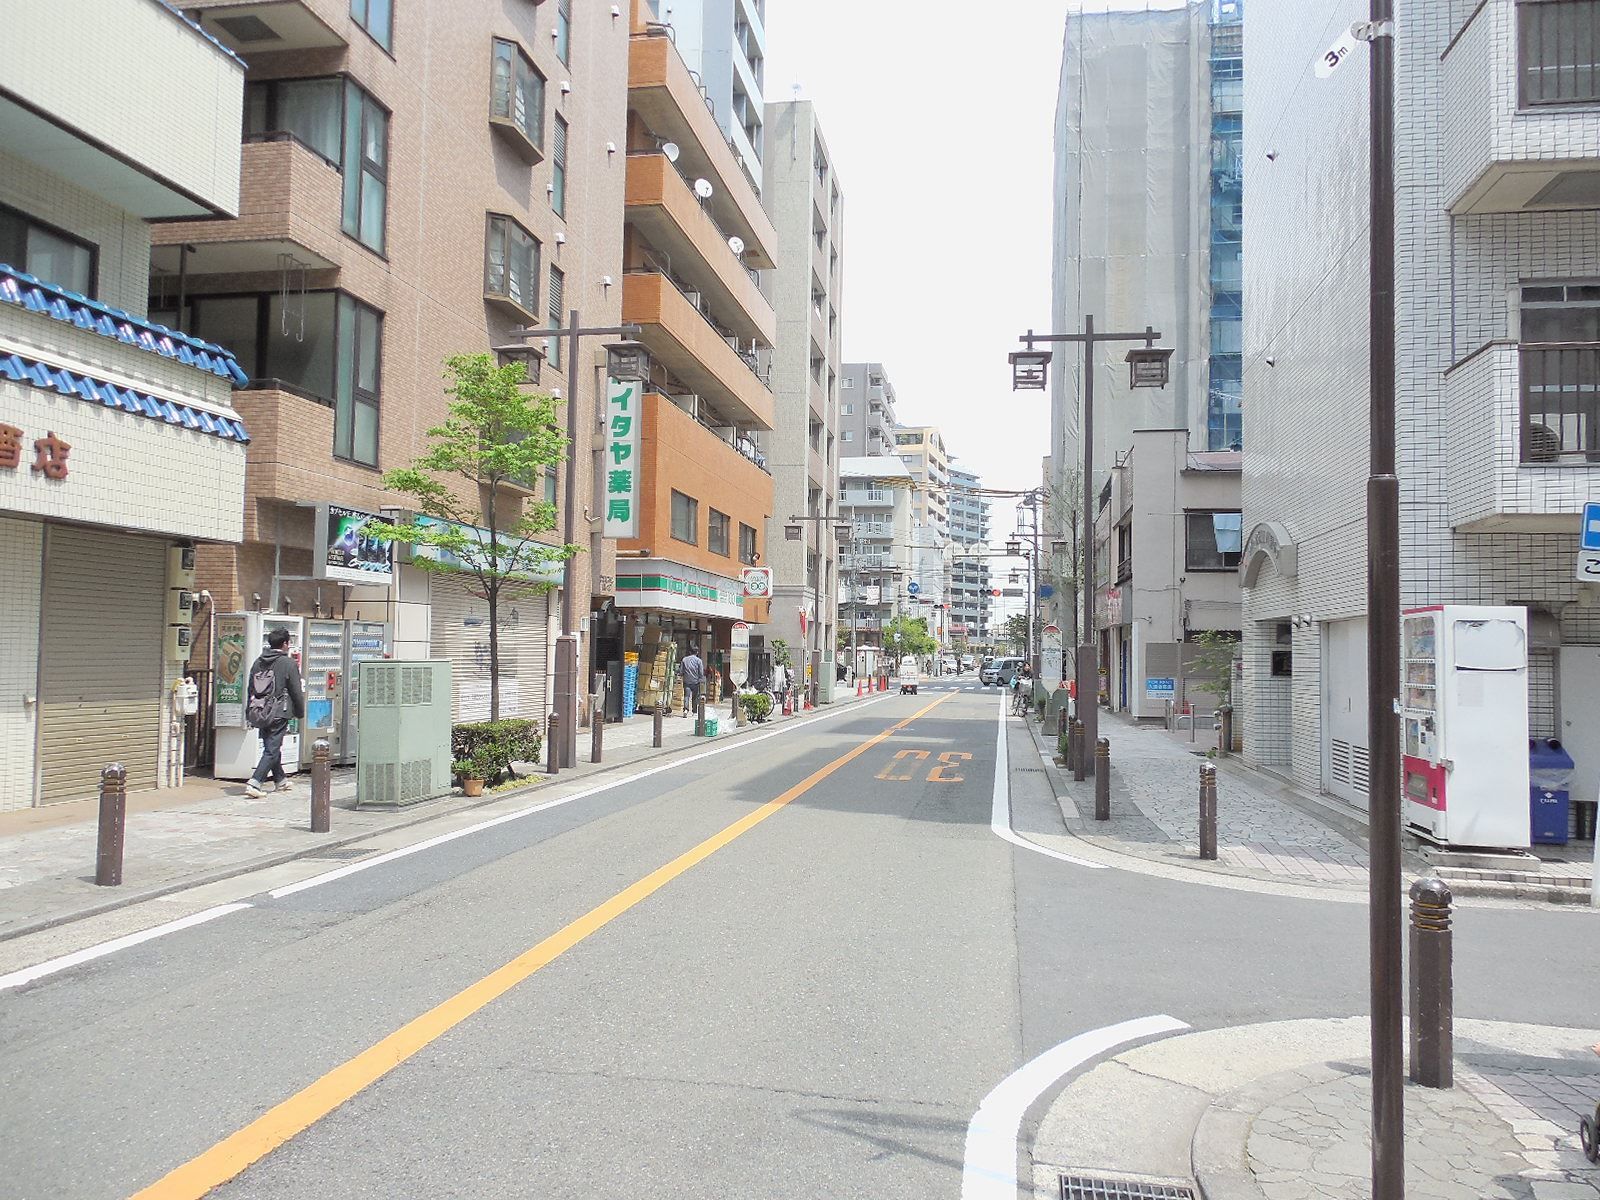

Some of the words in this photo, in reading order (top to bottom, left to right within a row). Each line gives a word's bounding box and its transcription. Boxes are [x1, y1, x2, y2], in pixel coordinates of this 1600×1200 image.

[1324, 46, 1348, 67] 3m
[606, 376, 633, 523] イタヤ薬局
